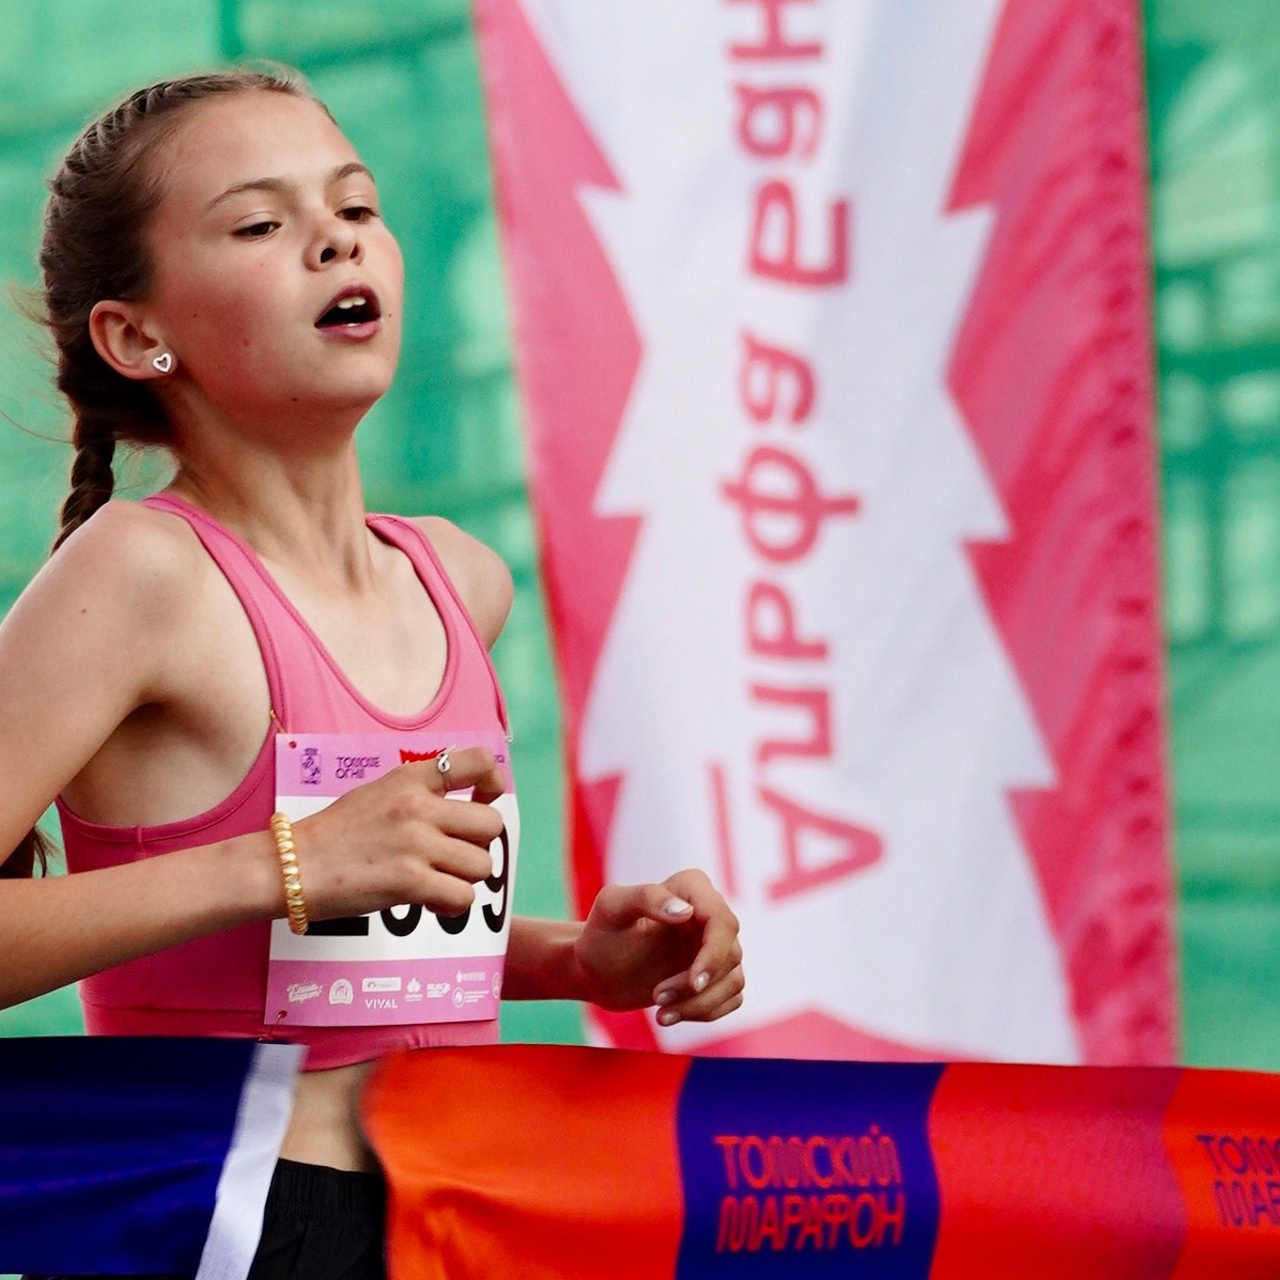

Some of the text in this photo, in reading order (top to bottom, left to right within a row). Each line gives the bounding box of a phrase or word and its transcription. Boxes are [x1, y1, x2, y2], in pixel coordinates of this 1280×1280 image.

[364, 998, 398, 1010] VIVAL
[714, 1124, 902, 1190] ТОМСКИЙ
[715, 1192, 906, 1254] МАРАФОН
